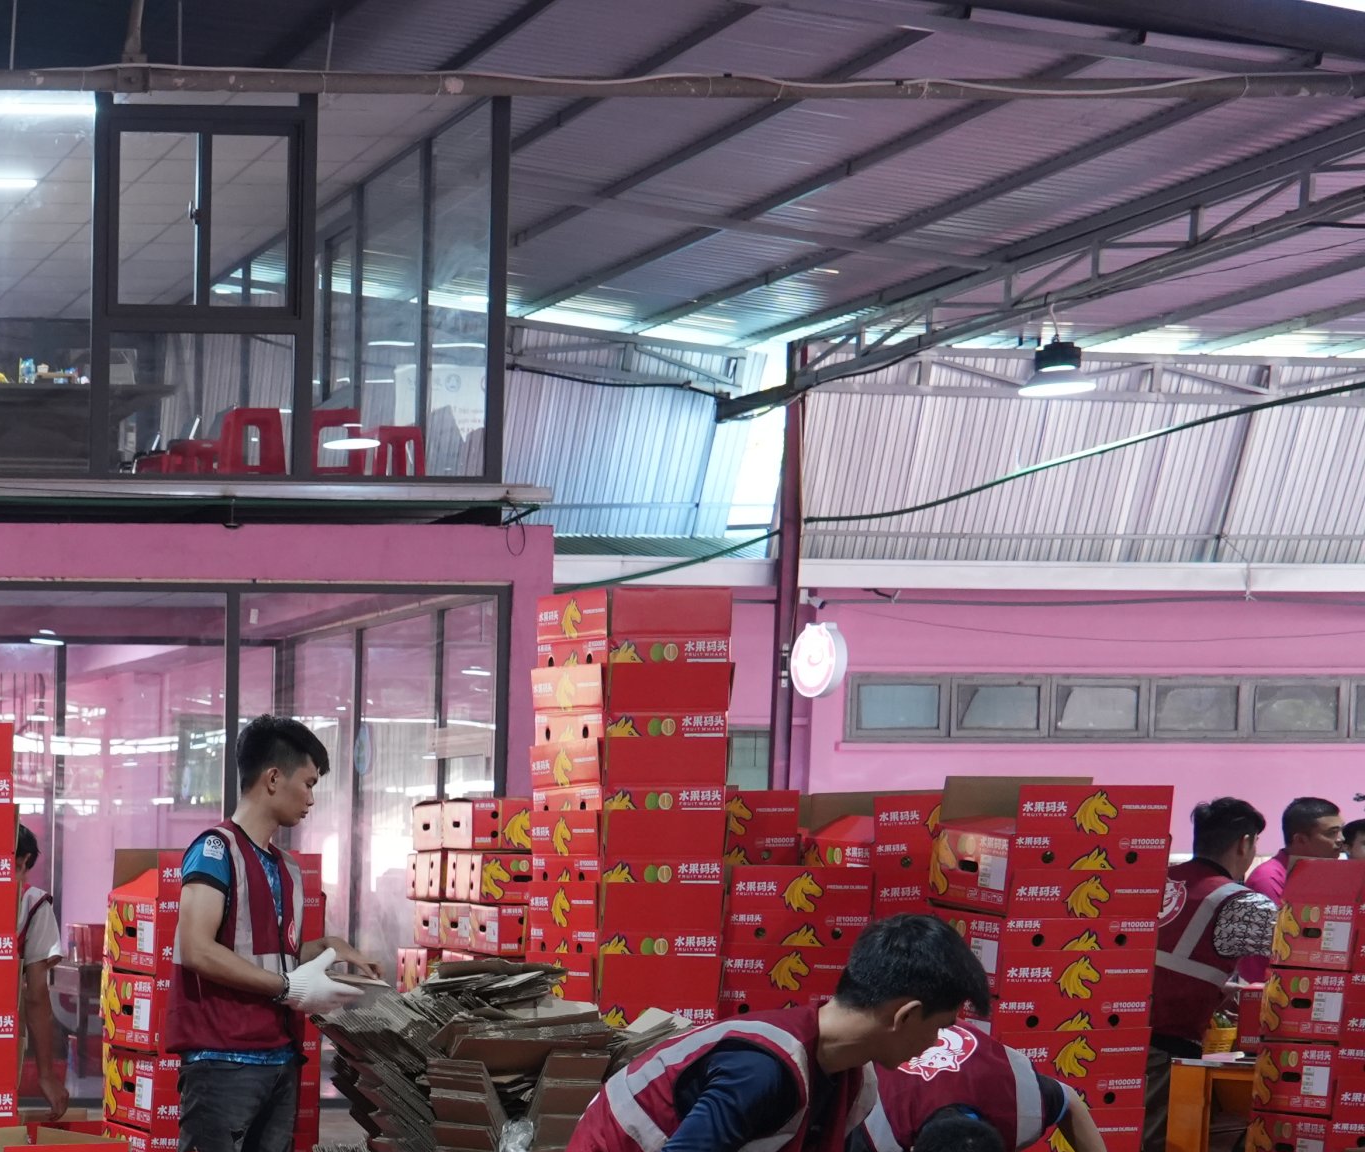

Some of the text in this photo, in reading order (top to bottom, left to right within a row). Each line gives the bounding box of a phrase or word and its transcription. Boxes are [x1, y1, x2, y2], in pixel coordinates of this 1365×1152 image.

[684, 641, 727, 652] 水果码头
[682, 716, 724, 727] 水果码头
[679, 790, 721, 801] 水果码头
[1023, 801, 1067, 813] 水果码头
[880, 811, 919, 822] 水果码头
[678, 864, 720, 874] 水果码头
[736, 881, 777, 892] 水果码头
[736, 881, 776, 893] 水果码头
[1016, 886, 1060, 897] 水果码头
[675, 936, 716, 947] 水果码头
[1007, 968, 1051, 978] 水果码头
